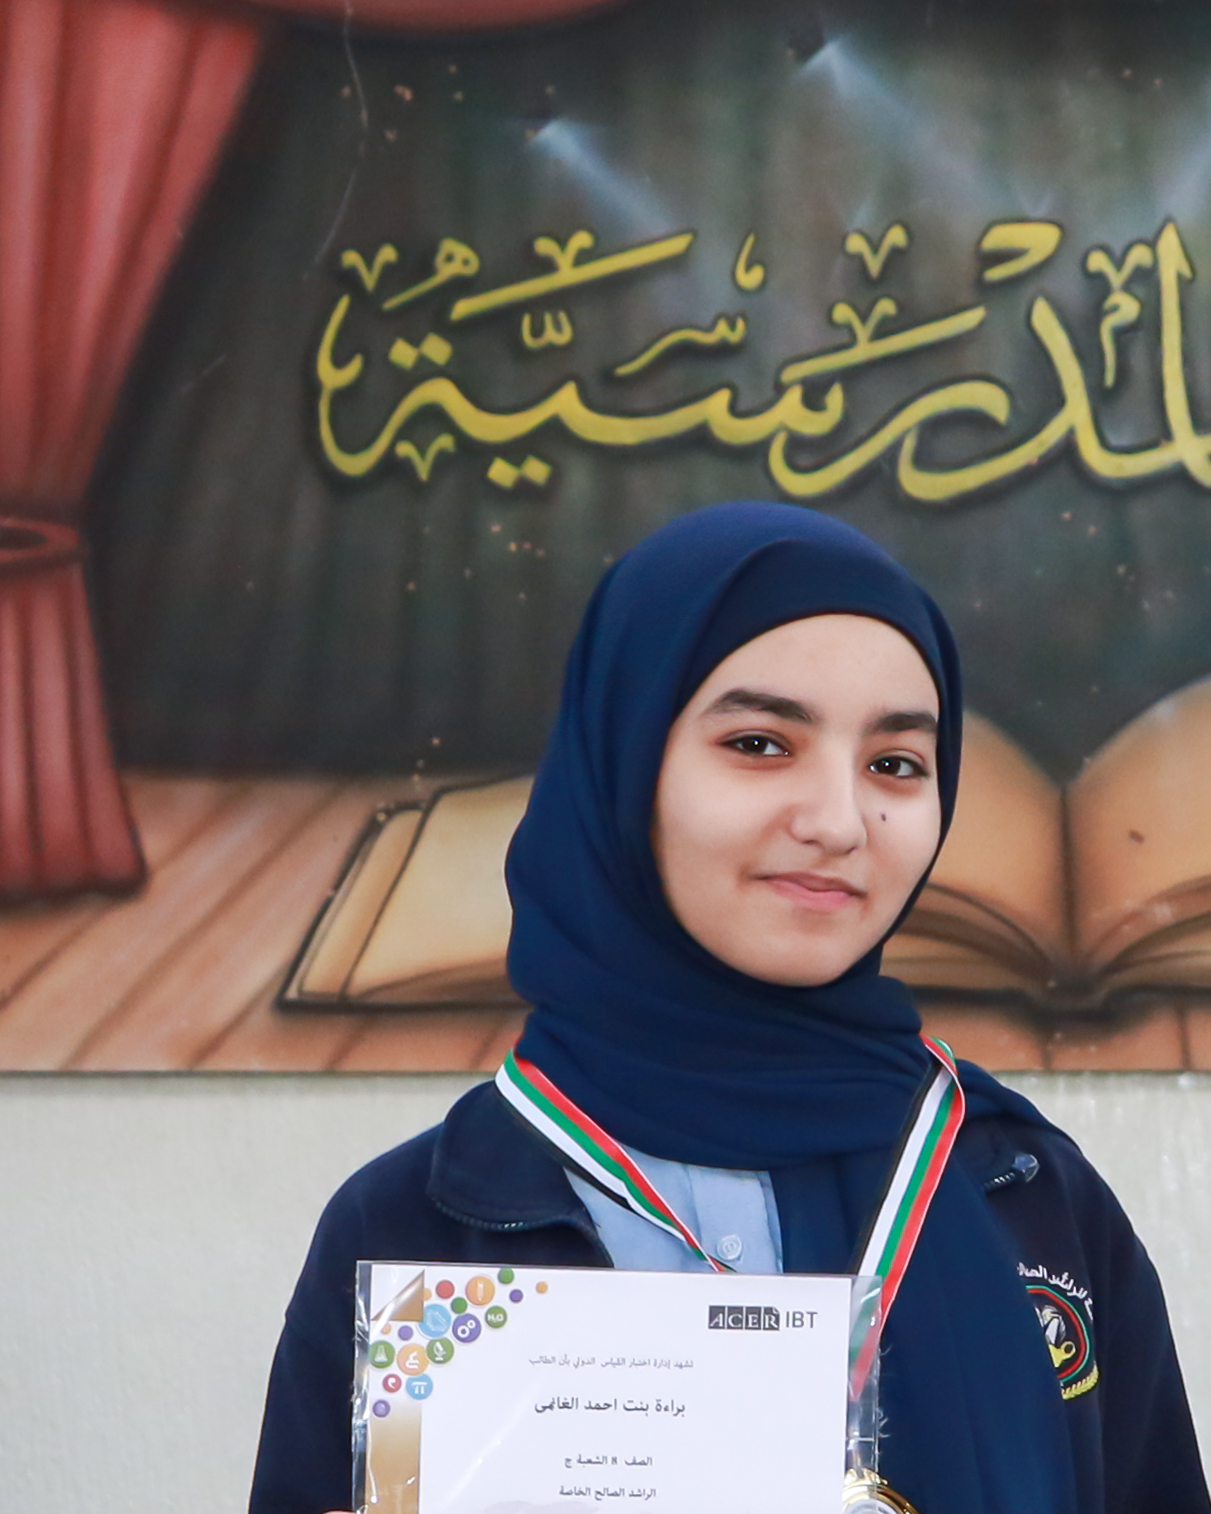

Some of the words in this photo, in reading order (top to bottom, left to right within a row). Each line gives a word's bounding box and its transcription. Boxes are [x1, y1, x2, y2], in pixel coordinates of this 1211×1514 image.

[709, 1309, 780, 1330] ACER
[785, 1311, 818, 1328] IBT
[583, 1398, 618, 1411] احمد
[622, 1399, 650, 1417] بنت
[654, 1398, 686, 1418] براءة
[576, 1453, 608, 1468] الشعبة
[624, 1456, 653, 1467] الصف
[558, 1485, 592, 1497] الخاصة
[594, 1487, 626, 1502] الصالح
[628, 1488, 657, 1502] الراشد
